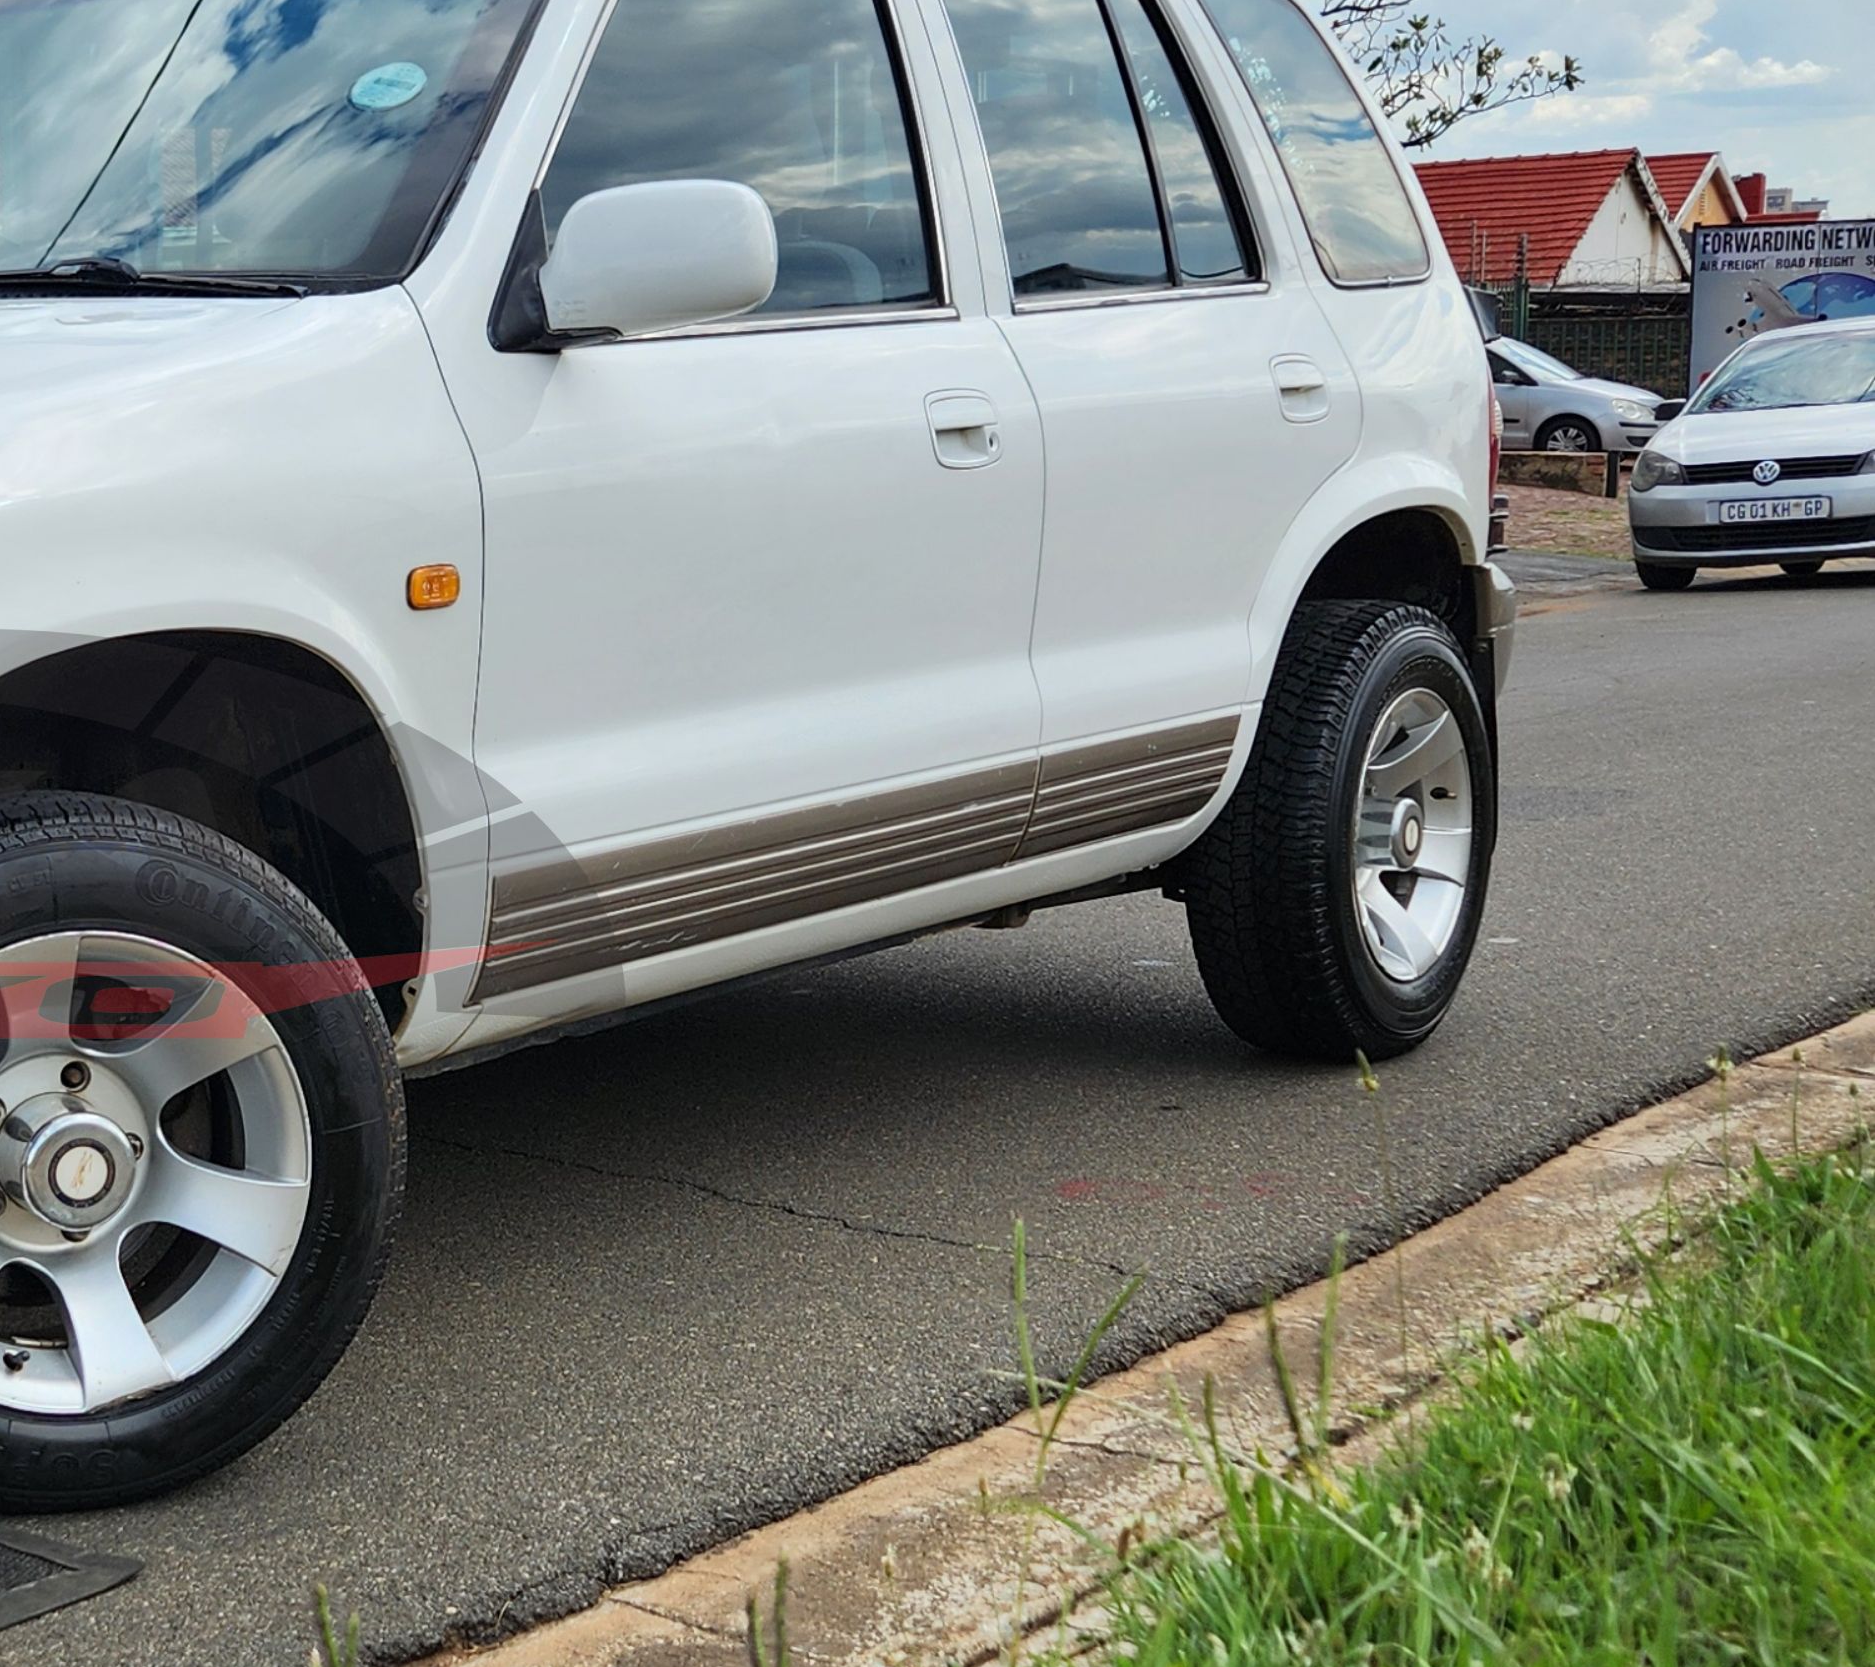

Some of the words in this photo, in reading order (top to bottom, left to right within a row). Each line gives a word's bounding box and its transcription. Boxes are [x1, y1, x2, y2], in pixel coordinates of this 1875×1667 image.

[1701, 228, 1816, 255] FORWARDING
[1821, 226, 1875, 251] NETW
[1699, 260, 1719, 272] AIR
[1721, 259, 1766, 272] FREIGHT
[1775, 257, 1806, 270] ROAD
[1809, 255, 1855, 269] FREIGHT
[1727, 503, 1746, 520] CG
[1771, 501, 1791, 518] KH
[1804, 499, 1823, 516] GP
